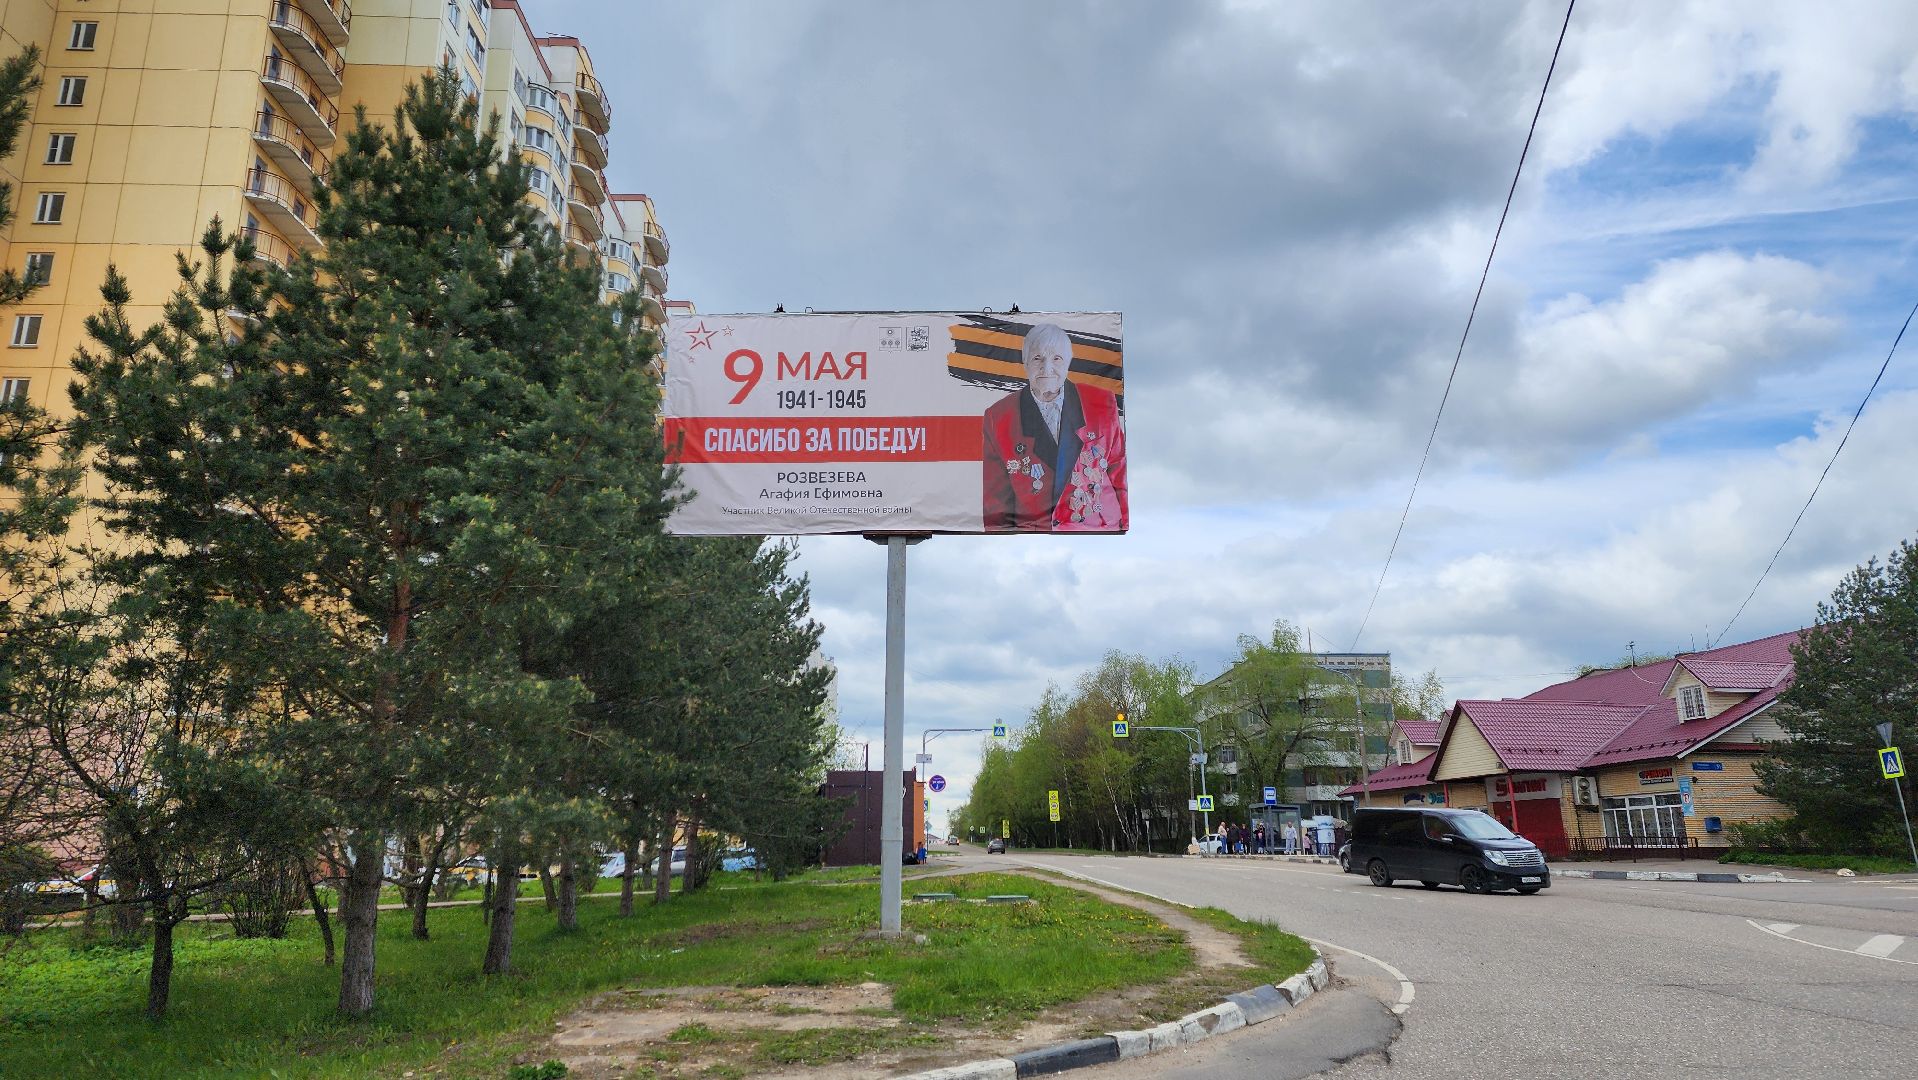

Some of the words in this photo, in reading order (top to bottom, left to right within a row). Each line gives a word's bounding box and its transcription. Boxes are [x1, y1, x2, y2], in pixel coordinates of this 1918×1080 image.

[723, 349, 764, 405] 9
[777, 351, 867, 381] МАЯ
[776, 389, 867, 409] 1941-1945
[704, 427, 800, 452] СПАСИБО
[805, 427, 832, 452] ЗА
[838, 427, 926, 453] ПОБЕДУ!
[777, 471, 867, 484] РОЗВЕЗЕВА
[759, 488, 810, 501] Агафия
[814, 487, 883, 501] Ефимовна
[721, 506, 765, 516] Участник
[767, 505, 807, 515] Великой
[809, 505, 880, 515] Отечественной
[882, 504, 912, 514] войны
